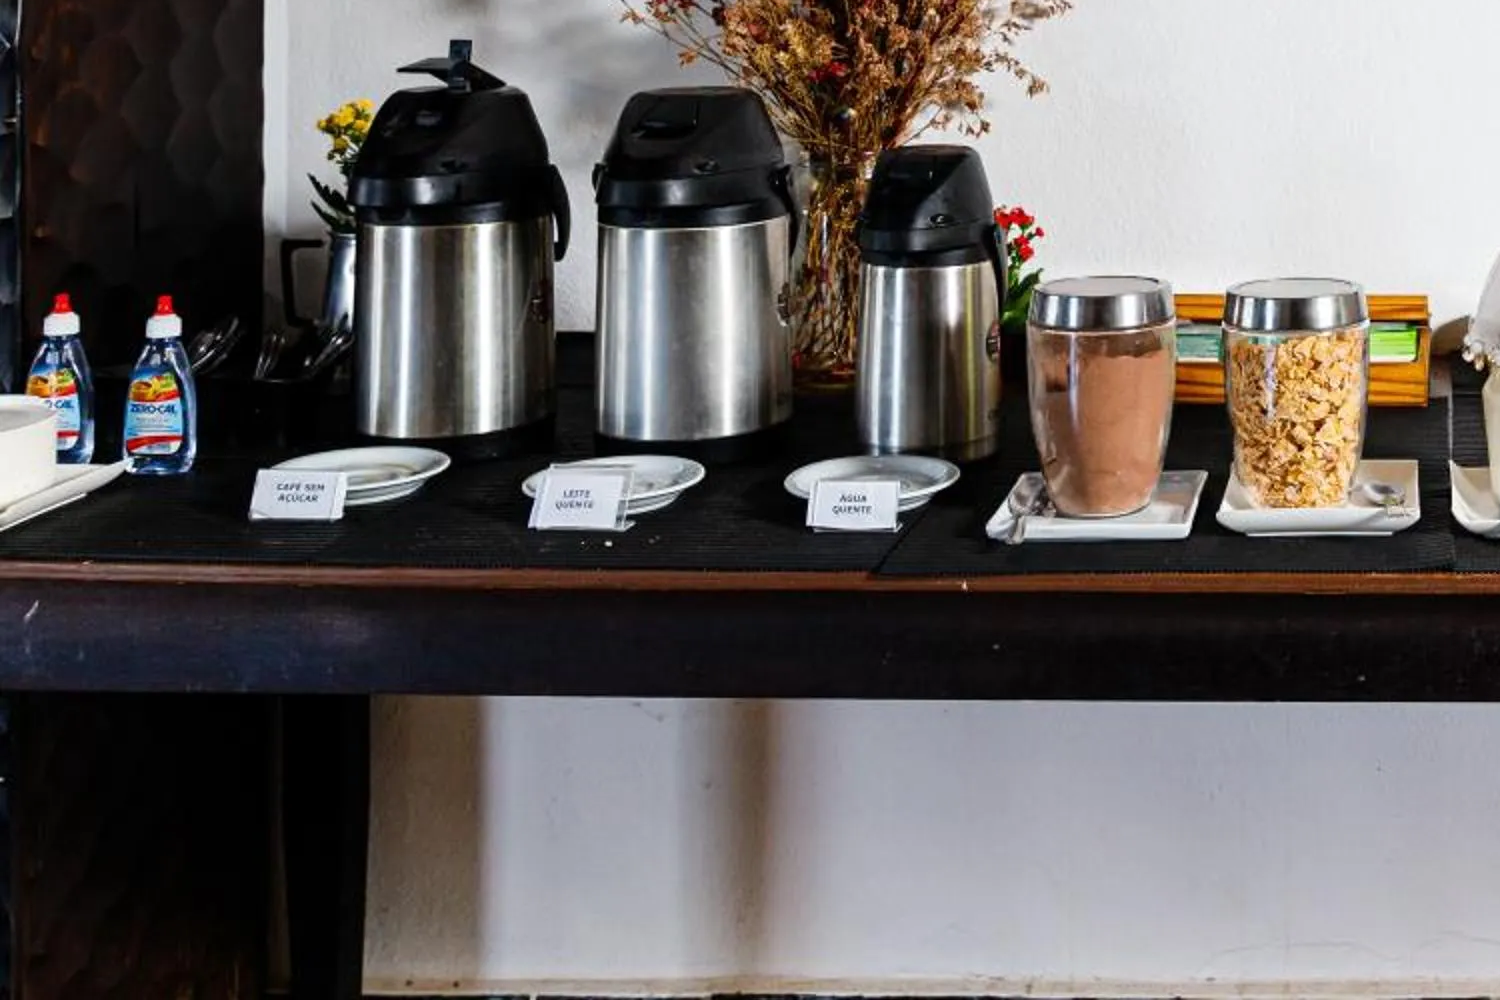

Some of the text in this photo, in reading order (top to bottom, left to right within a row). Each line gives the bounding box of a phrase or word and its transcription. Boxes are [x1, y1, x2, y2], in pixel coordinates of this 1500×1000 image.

[563, 489, 591, 498] LEITE
[555, 501, 593, 510] QUENTE
[831, 505, 873, 515] QUENTE
